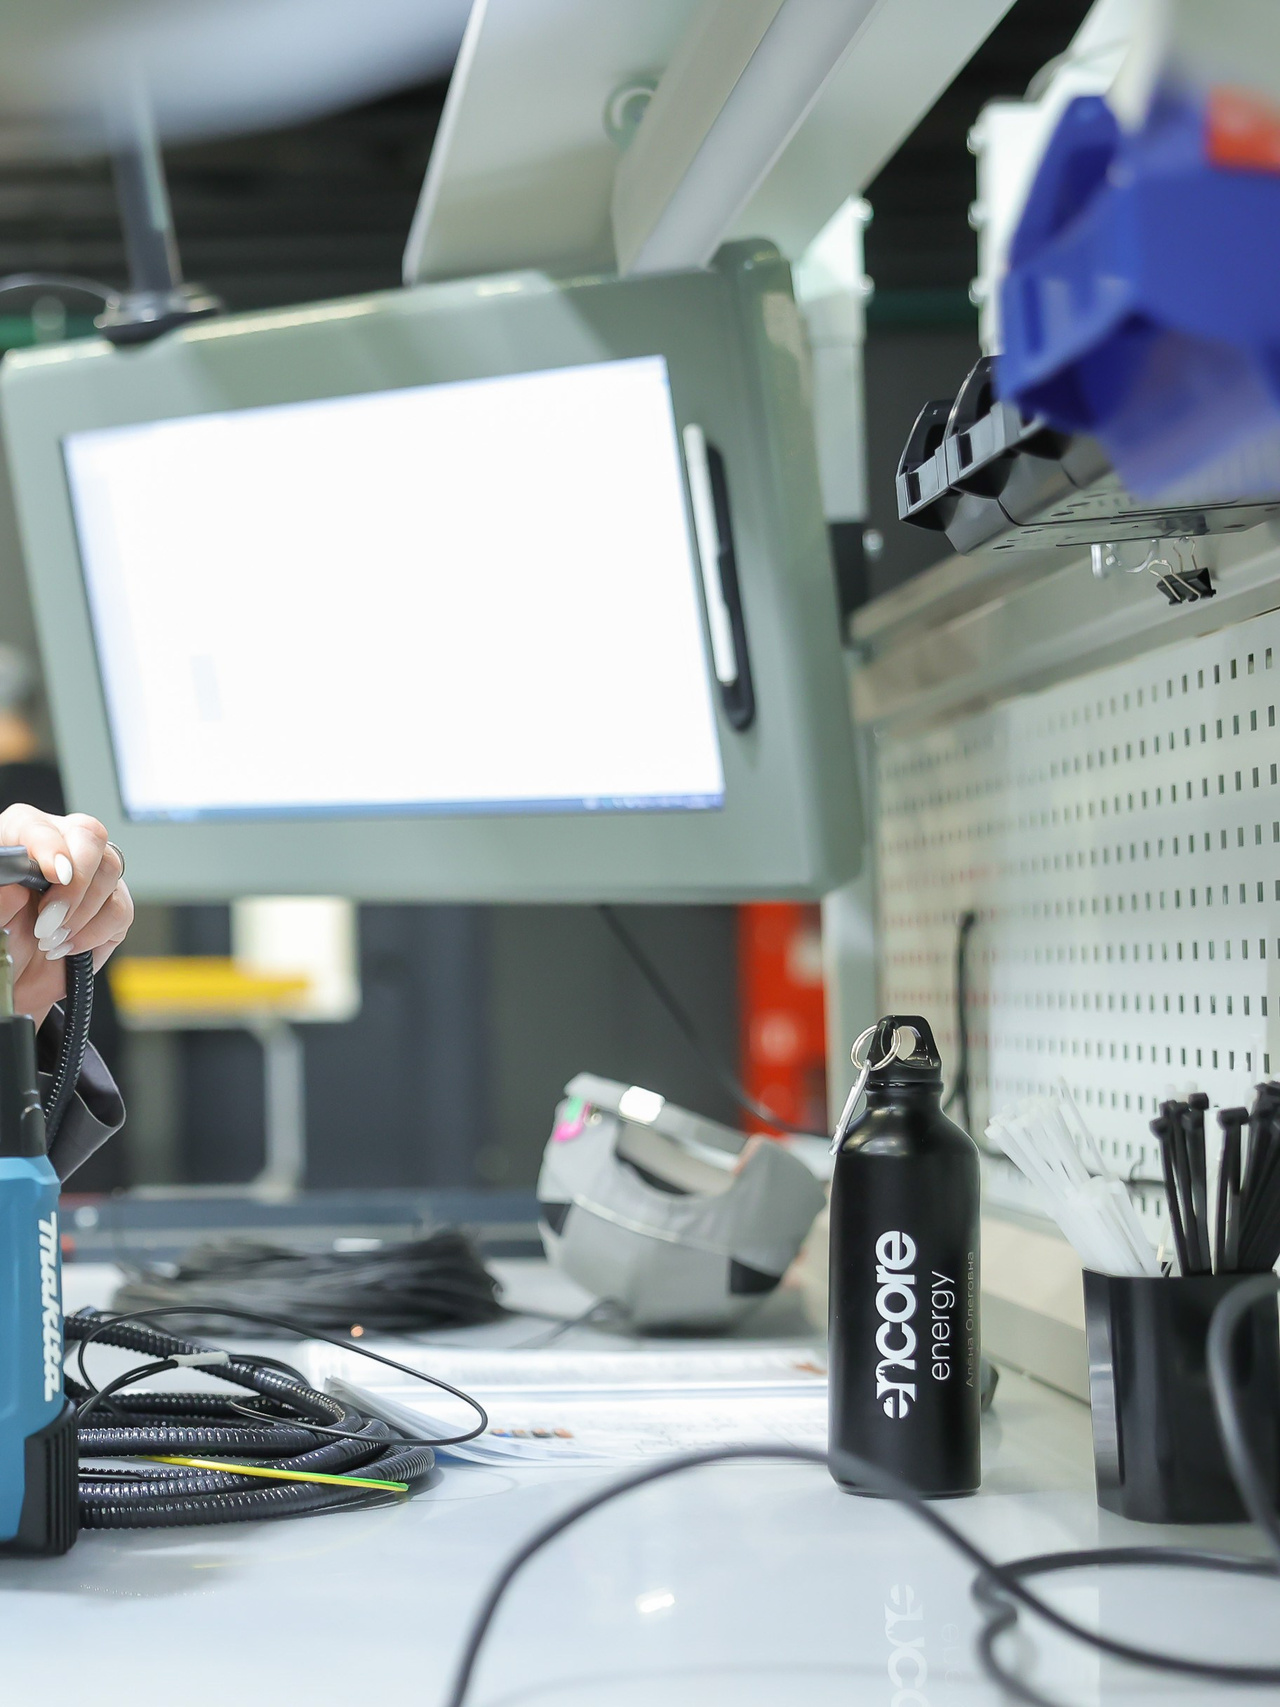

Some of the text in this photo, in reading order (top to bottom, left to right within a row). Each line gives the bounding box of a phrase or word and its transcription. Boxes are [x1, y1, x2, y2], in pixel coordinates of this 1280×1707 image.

[875, 1230, 917, 1419] encore
[931, 1270, 955, 1381] energy
[965, 1251, 974, 1331] Олеговна
